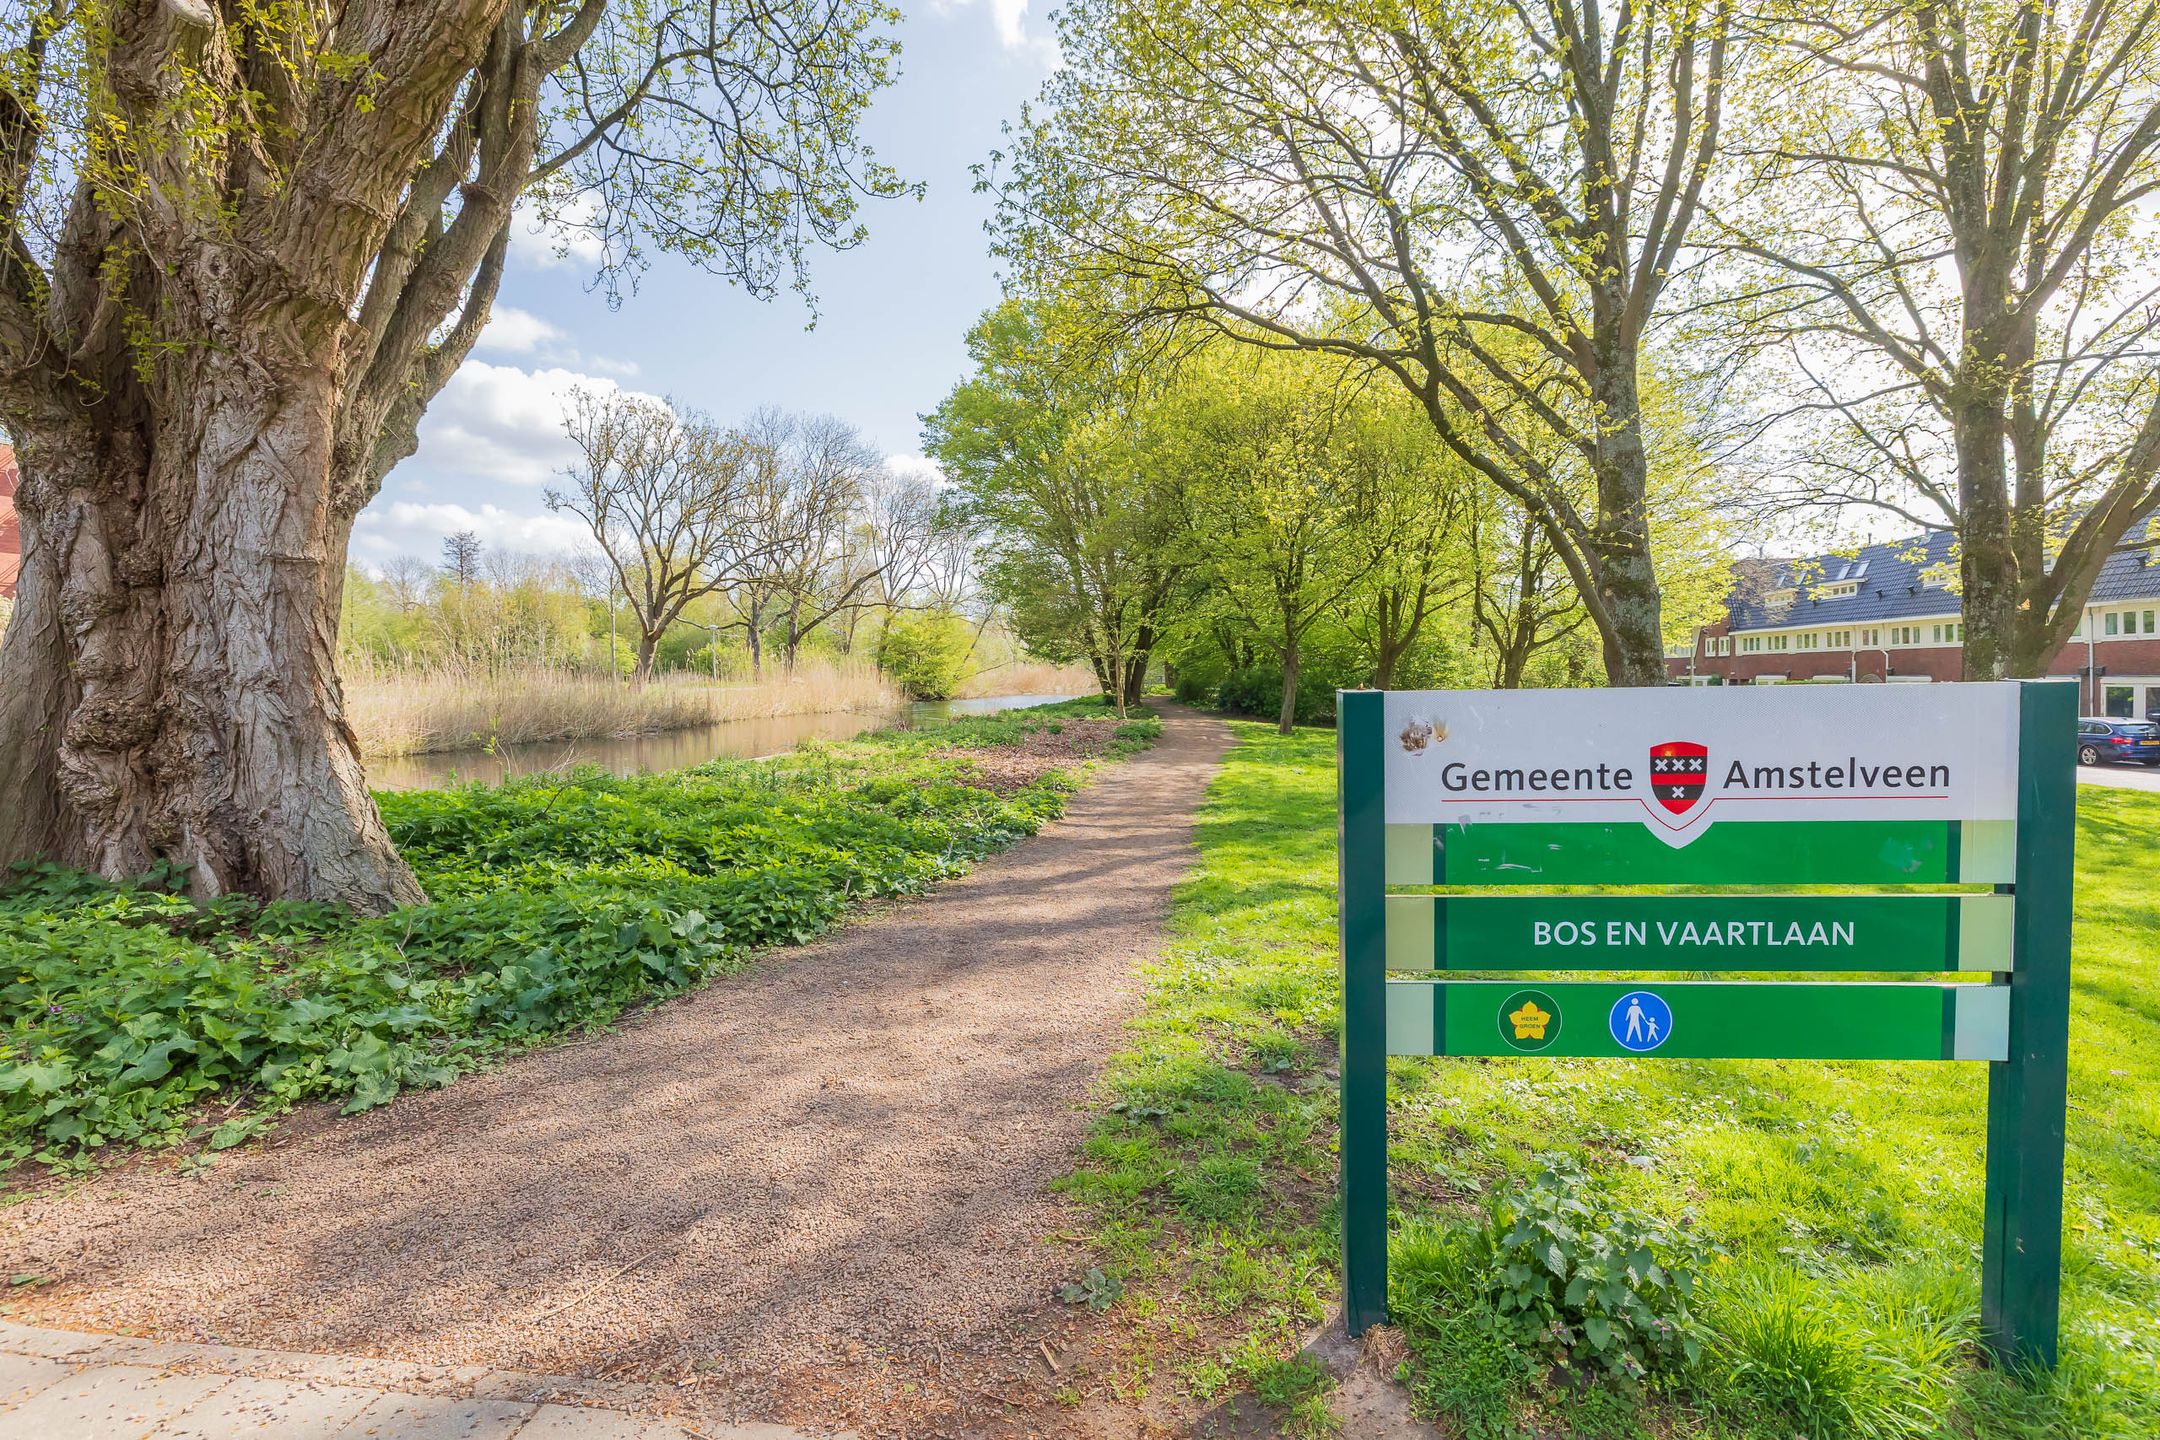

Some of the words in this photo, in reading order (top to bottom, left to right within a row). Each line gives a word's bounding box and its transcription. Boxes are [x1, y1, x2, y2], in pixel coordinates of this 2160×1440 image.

[1441, 762, 1633, 792] Gemeente
[1722, 756, 1950, 789] Amstelveen
[1534, 922, 1596, 946] BOS
[1606, 922, 1645, 946] EN
[1655, 921, 1854, 946] VAARTLAAN
